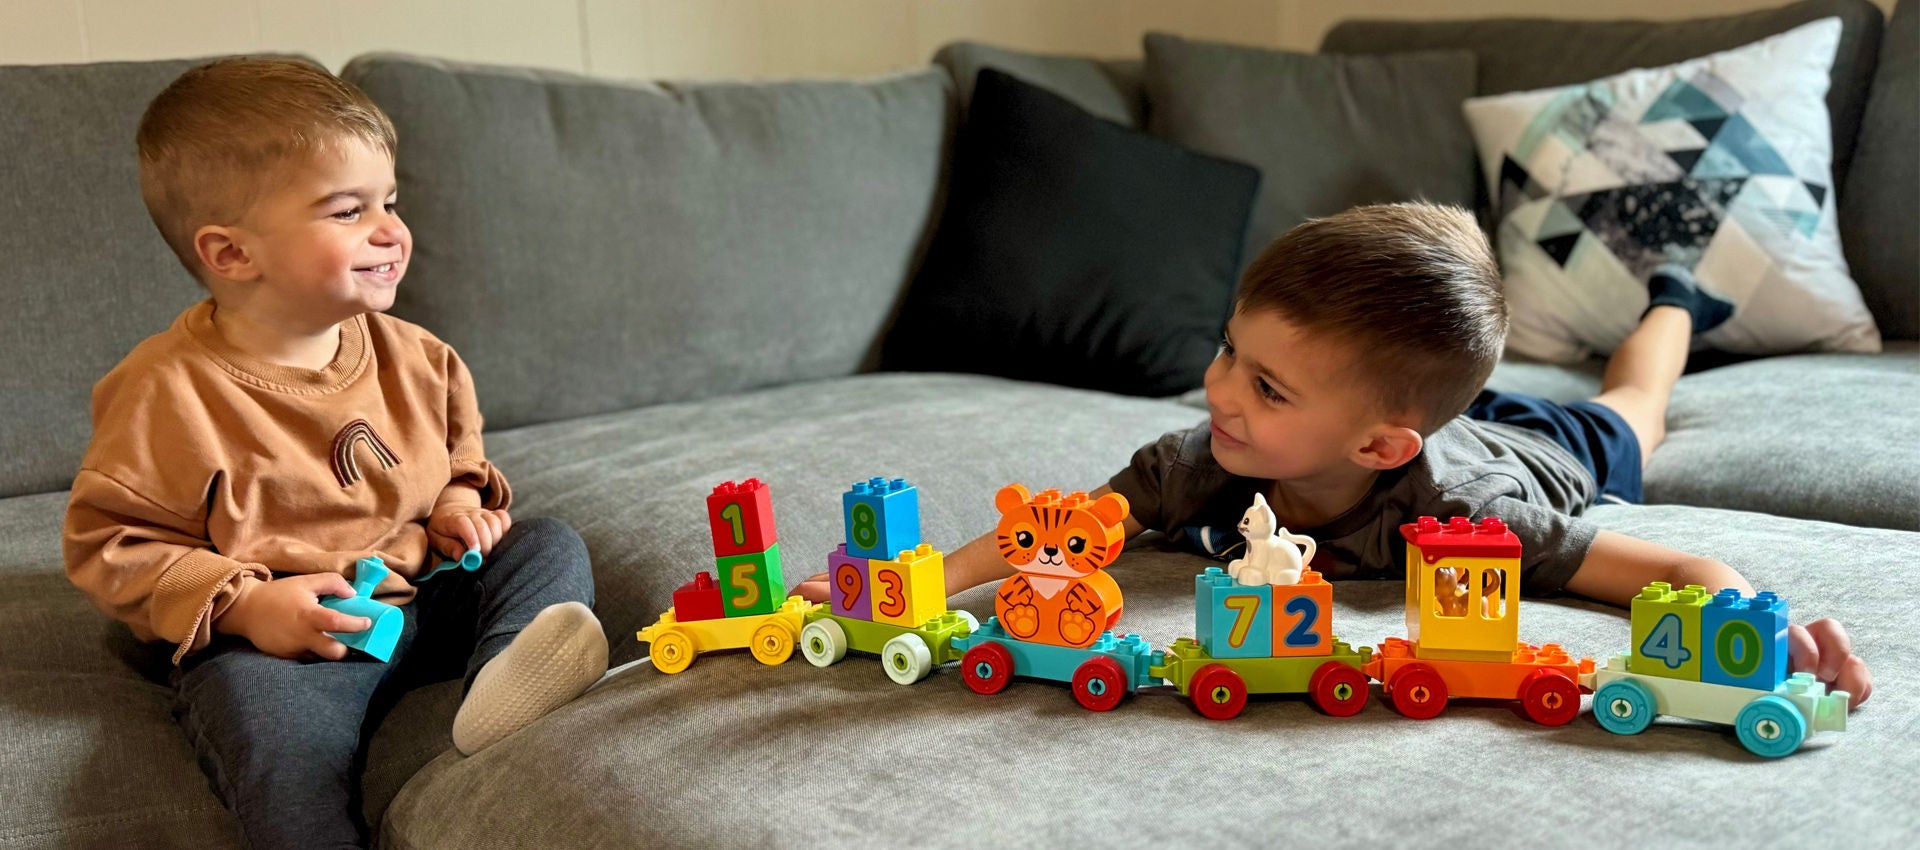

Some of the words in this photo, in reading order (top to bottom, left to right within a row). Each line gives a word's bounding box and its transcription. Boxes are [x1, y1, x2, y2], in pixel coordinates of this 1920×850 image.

[720, 502, 746, 547] 1
[851, 502, 878, 549] 8
[730, 562, 760, 609] 5
[836, 563, 863, 612] 9
[878, 569, 906, 618] 3
[1224, 595, 1260, 648] 7
[1284, 595, 1321, 647] 2
[1640, 612, 1692, 669] 4
[1714, 620, 1763, 677] 0
